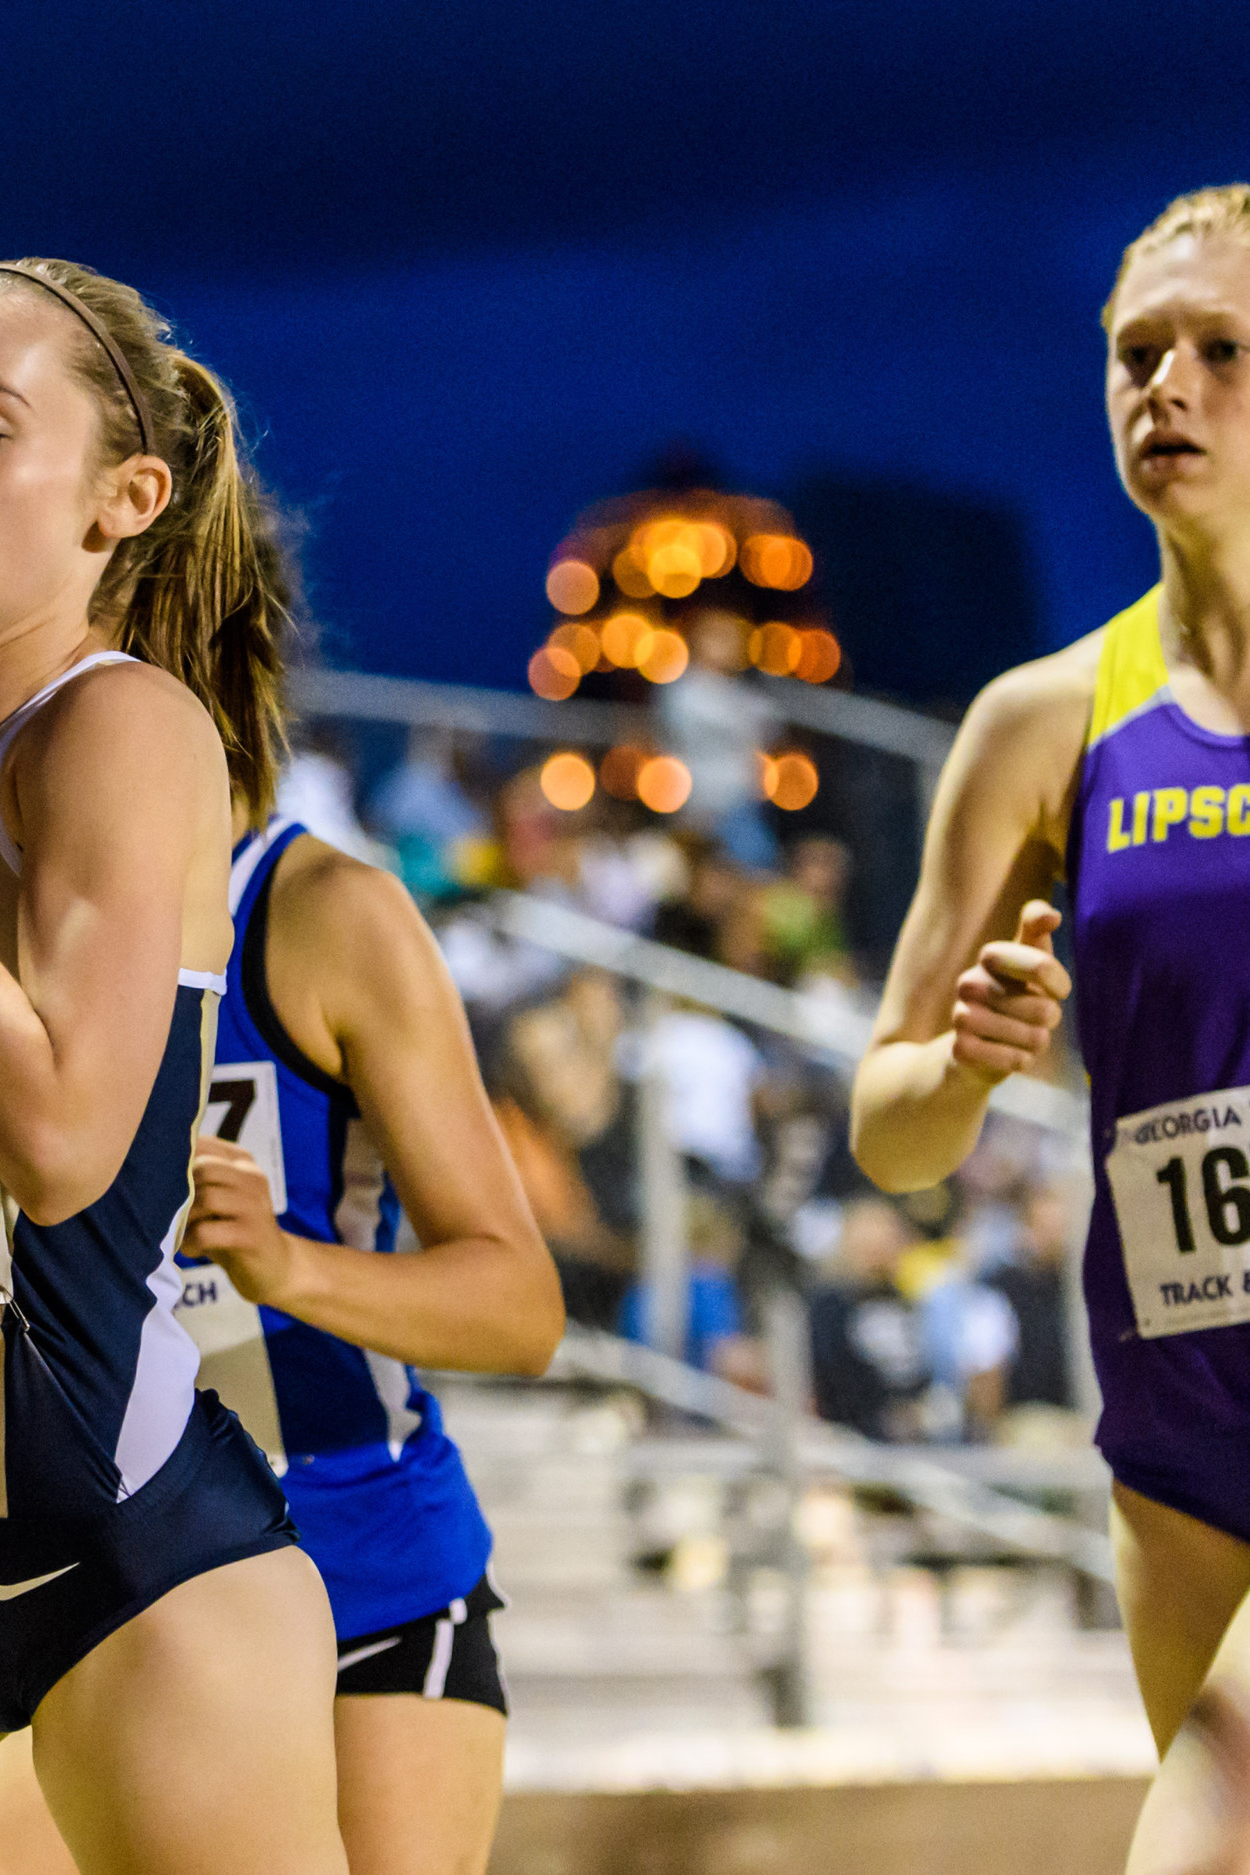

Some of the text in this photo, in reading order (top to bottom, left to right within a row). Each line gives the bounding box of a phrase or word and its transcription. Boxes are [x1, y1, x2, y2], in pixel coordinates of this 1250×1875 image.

[1107, 783, 1250, 853] LIPSC
[208, 1079, 255, 1143] 7
[1135, 1106, 1242, 1144] GEORGIA
[1160, 1274, 1232, 1306] TRACK
